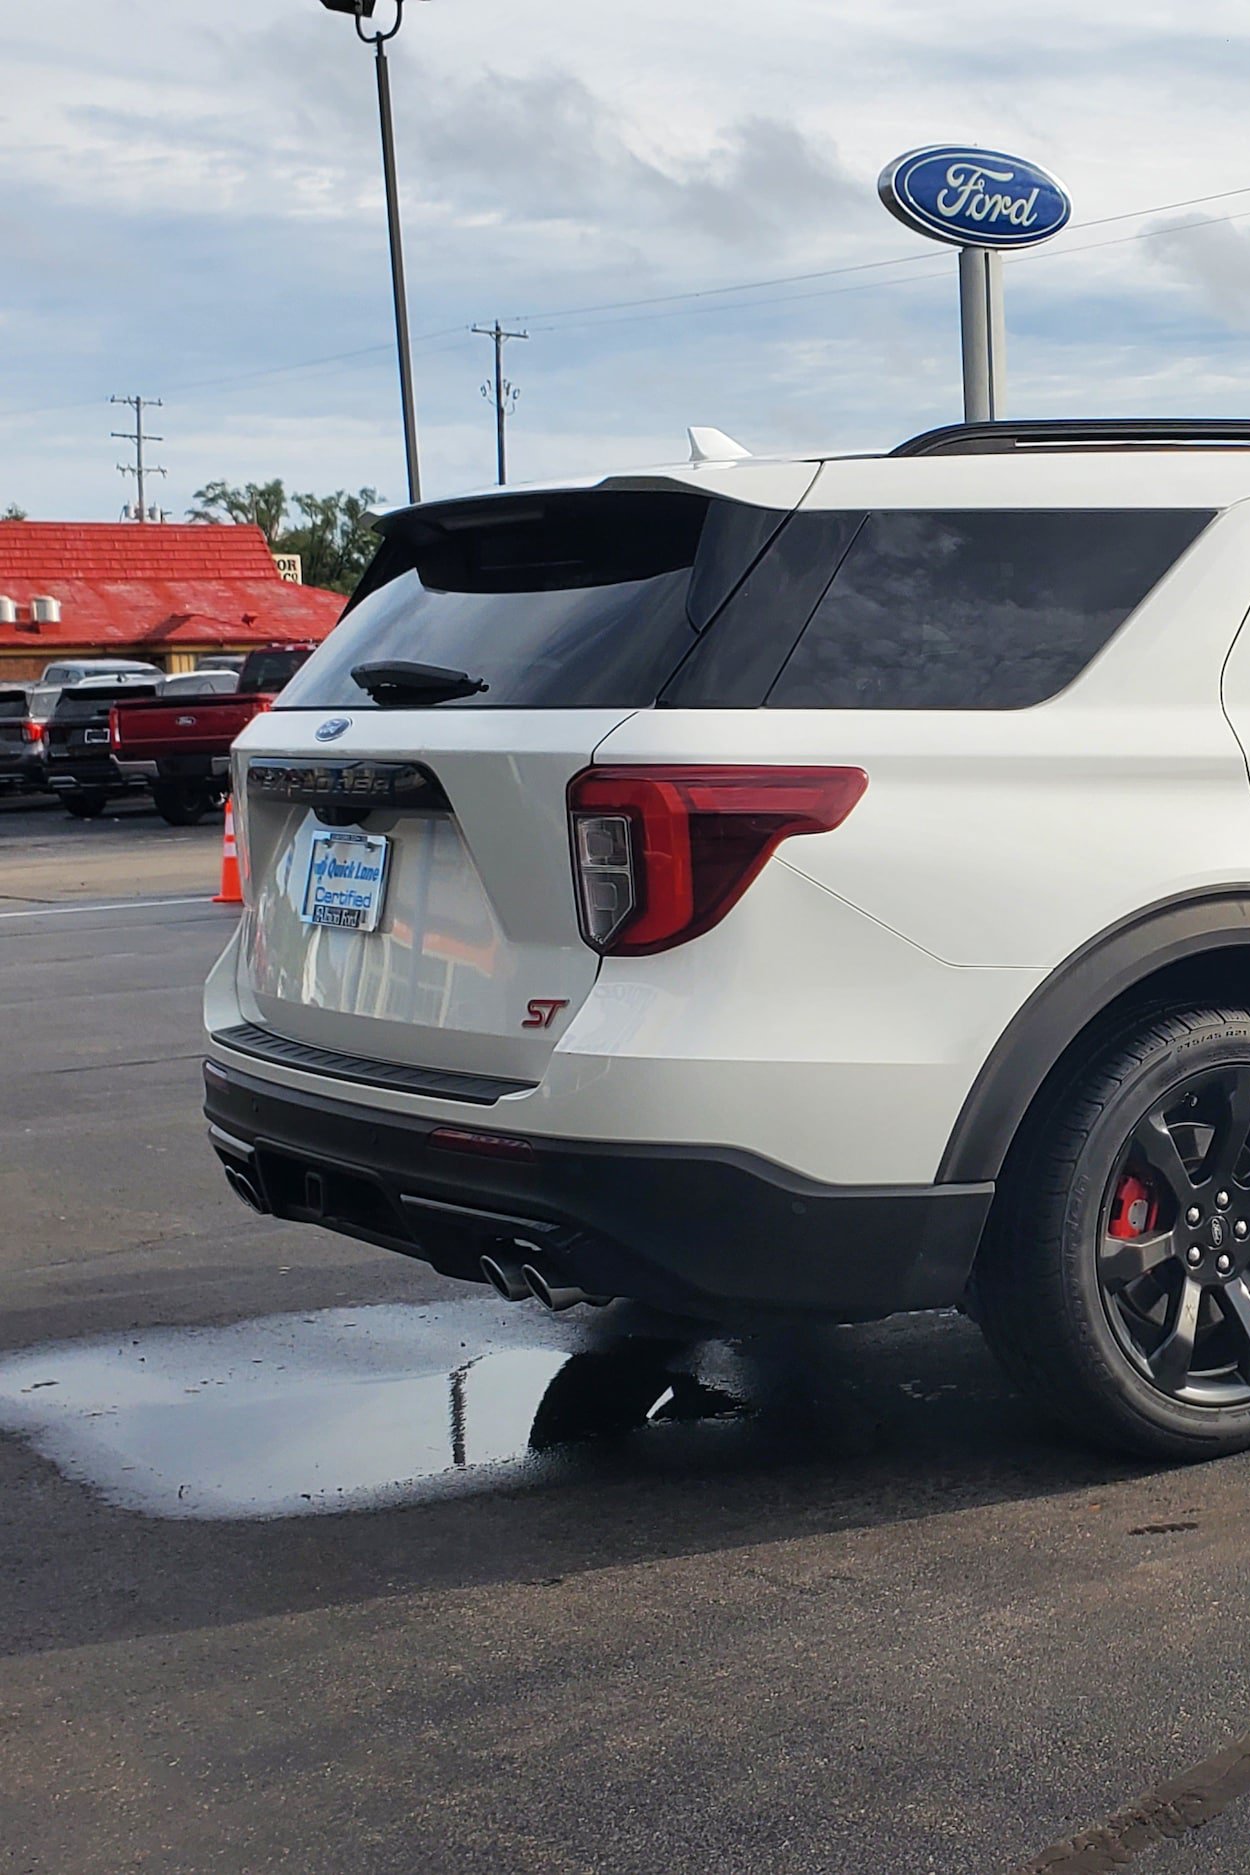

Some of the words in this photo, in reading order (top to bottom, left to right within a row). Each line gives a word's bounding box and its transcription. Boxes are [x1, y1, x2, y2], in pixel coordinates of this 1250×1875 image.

[937, 163, 1040, 227] Ford
[274, 559, 296, 571] OR
[327, 858, 357, 879] Quick
[356, 861, 380, 881] Lane
[315, 886, 372, 908] Certified
[521, 999, 570, 1029] ST
